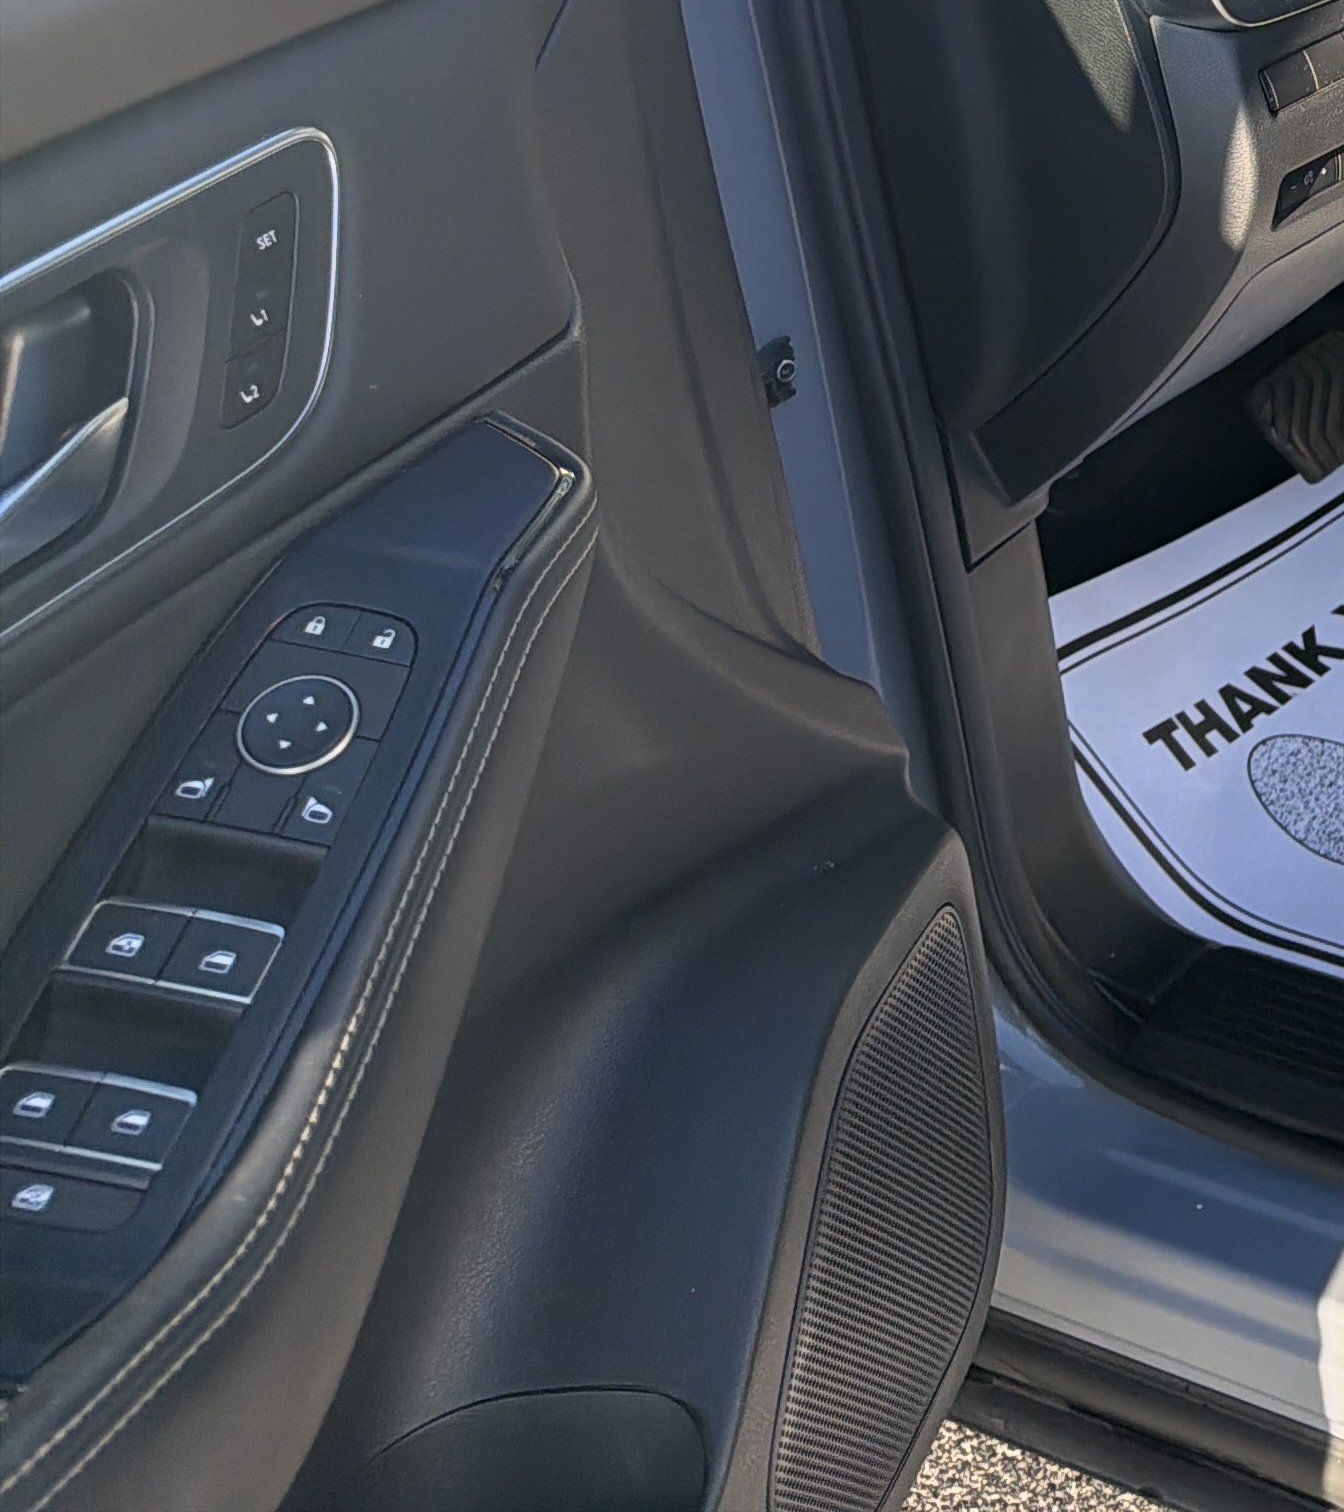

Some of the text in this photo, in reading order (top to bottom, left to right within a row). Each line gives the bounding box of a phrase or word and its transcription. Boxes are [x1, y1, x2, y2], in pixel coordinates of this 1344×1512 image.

[257, 230, 277, 250] SET
[250, 309, 268, 326] L1
[239, 385, 260, 403] L2
